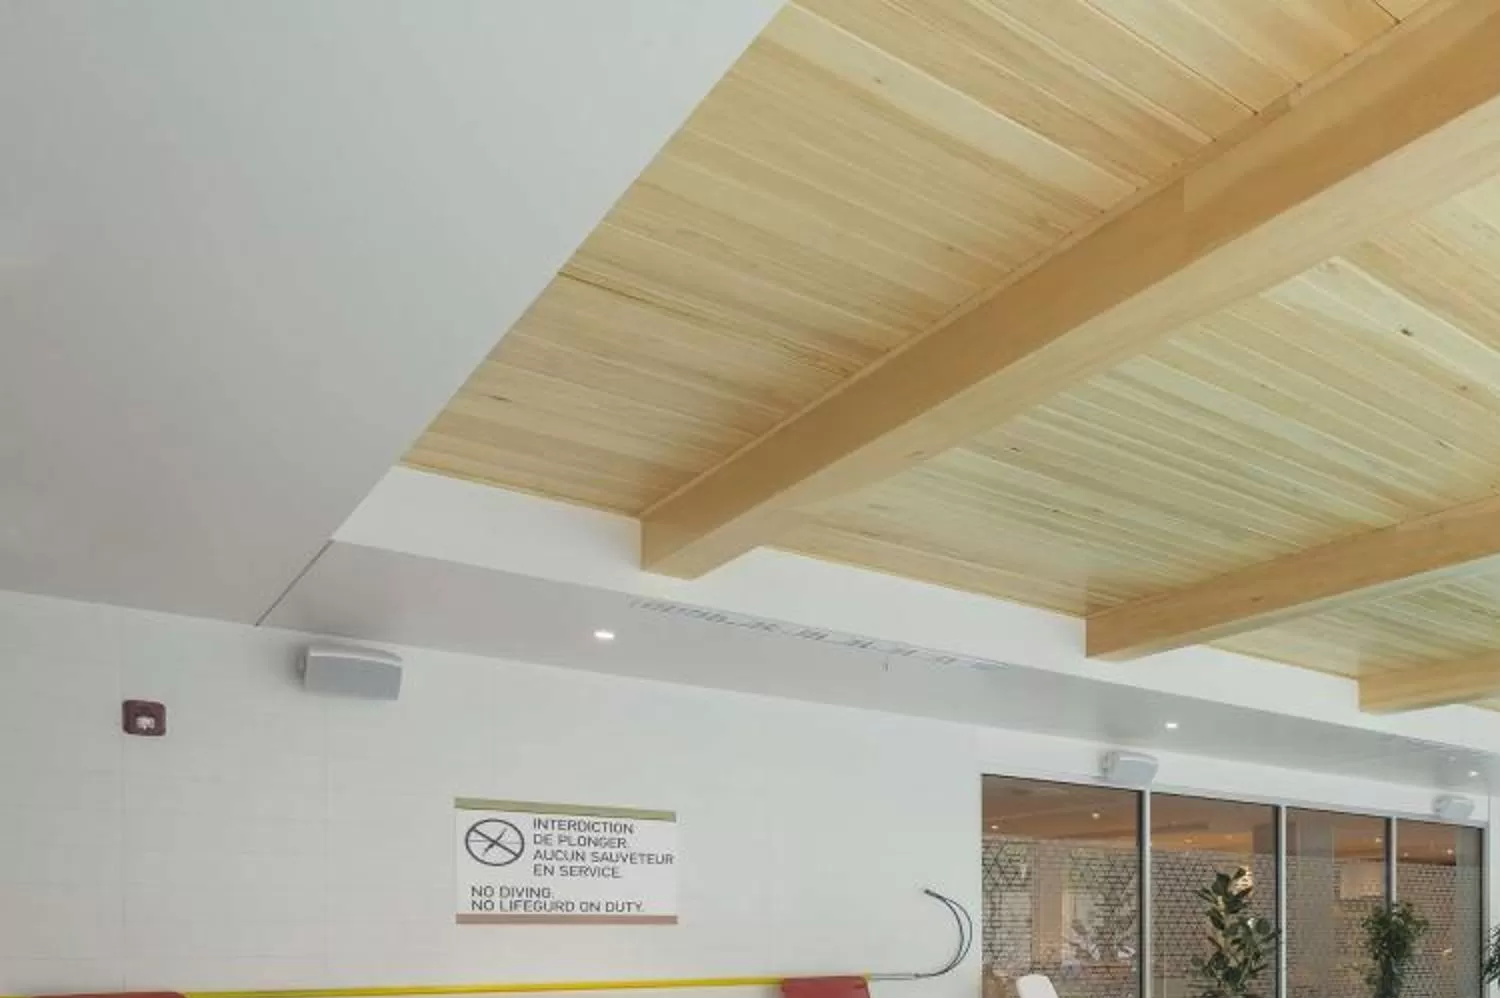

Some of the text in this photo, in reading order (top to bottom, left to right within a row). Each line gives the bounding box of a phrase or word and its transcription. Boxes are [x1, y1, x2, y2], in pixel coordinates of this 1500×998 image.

[533, 818, 634, 835] INTERDICTION
[533, 833, 553, 847] DE
[533, 849, 674, 865] AUCUN SAUVETEUR
[533, 863, 554, 877] EN
[471, 885, 495, 898] NO
[471, 899, 495, 911] NO
[579, 901, 600, 912] ON
